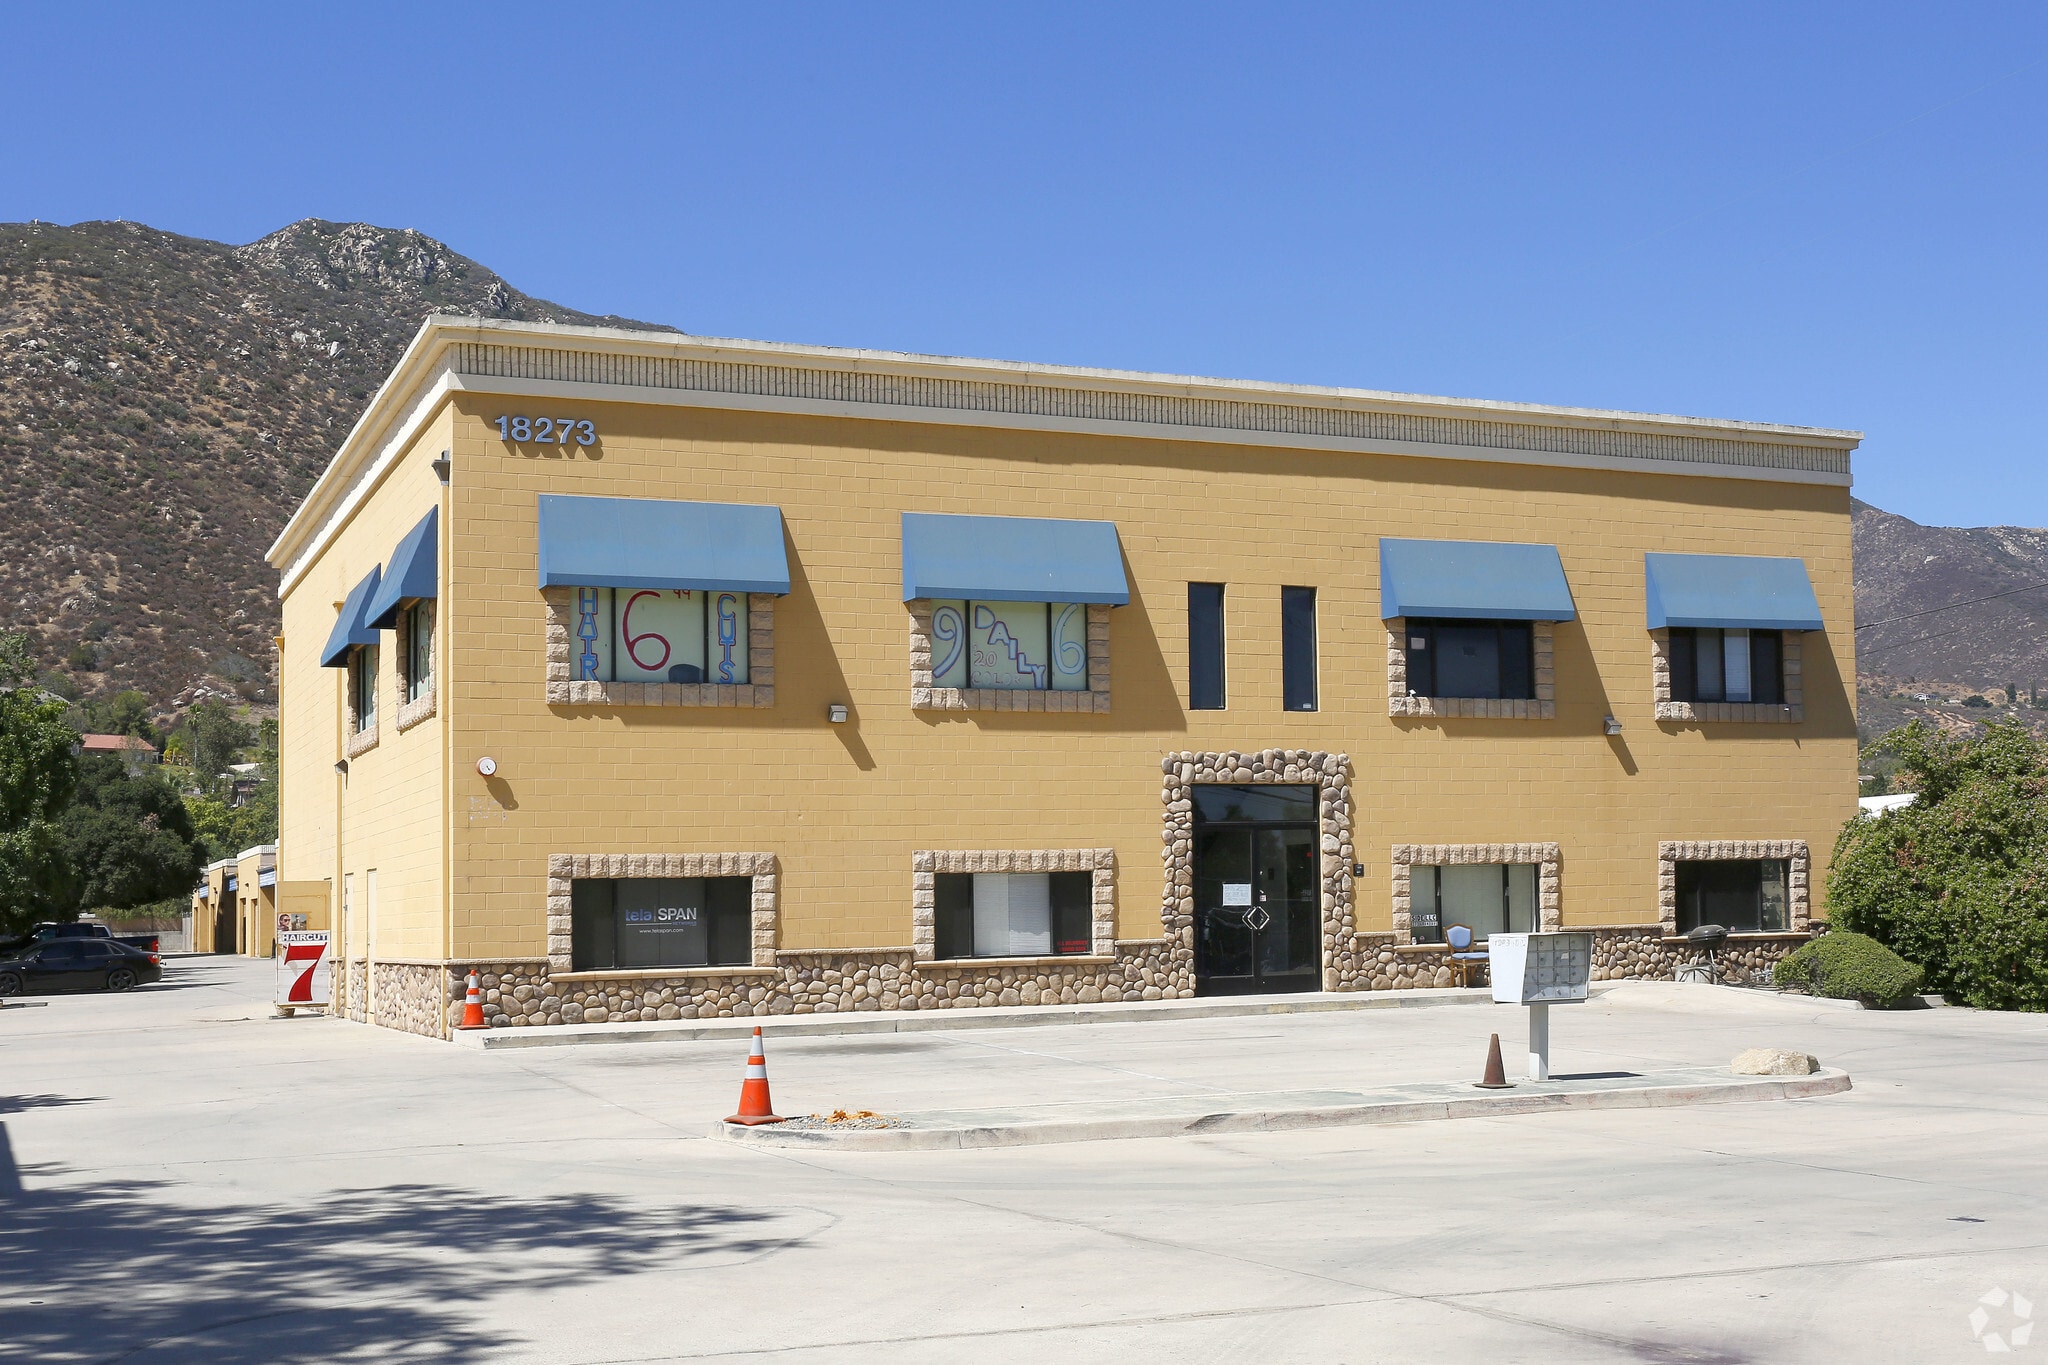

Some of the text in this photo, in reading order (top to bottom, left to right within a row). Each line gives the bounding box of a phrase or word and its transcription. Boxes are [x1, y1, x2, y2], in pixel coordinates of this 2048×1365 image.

[494, 415, 597, 446] 18273
[622, 590, 671, 671] 6
[717, 593, 736, 683] CUTS
[932, 605, 964, 679] 9
[974, 604, 1046, 689] DAILY
[281, 933, 328, 942] HAIRCUT
[625, 907, 697, 922] tela SPAN
[283, 941, 328, 1002] 7
